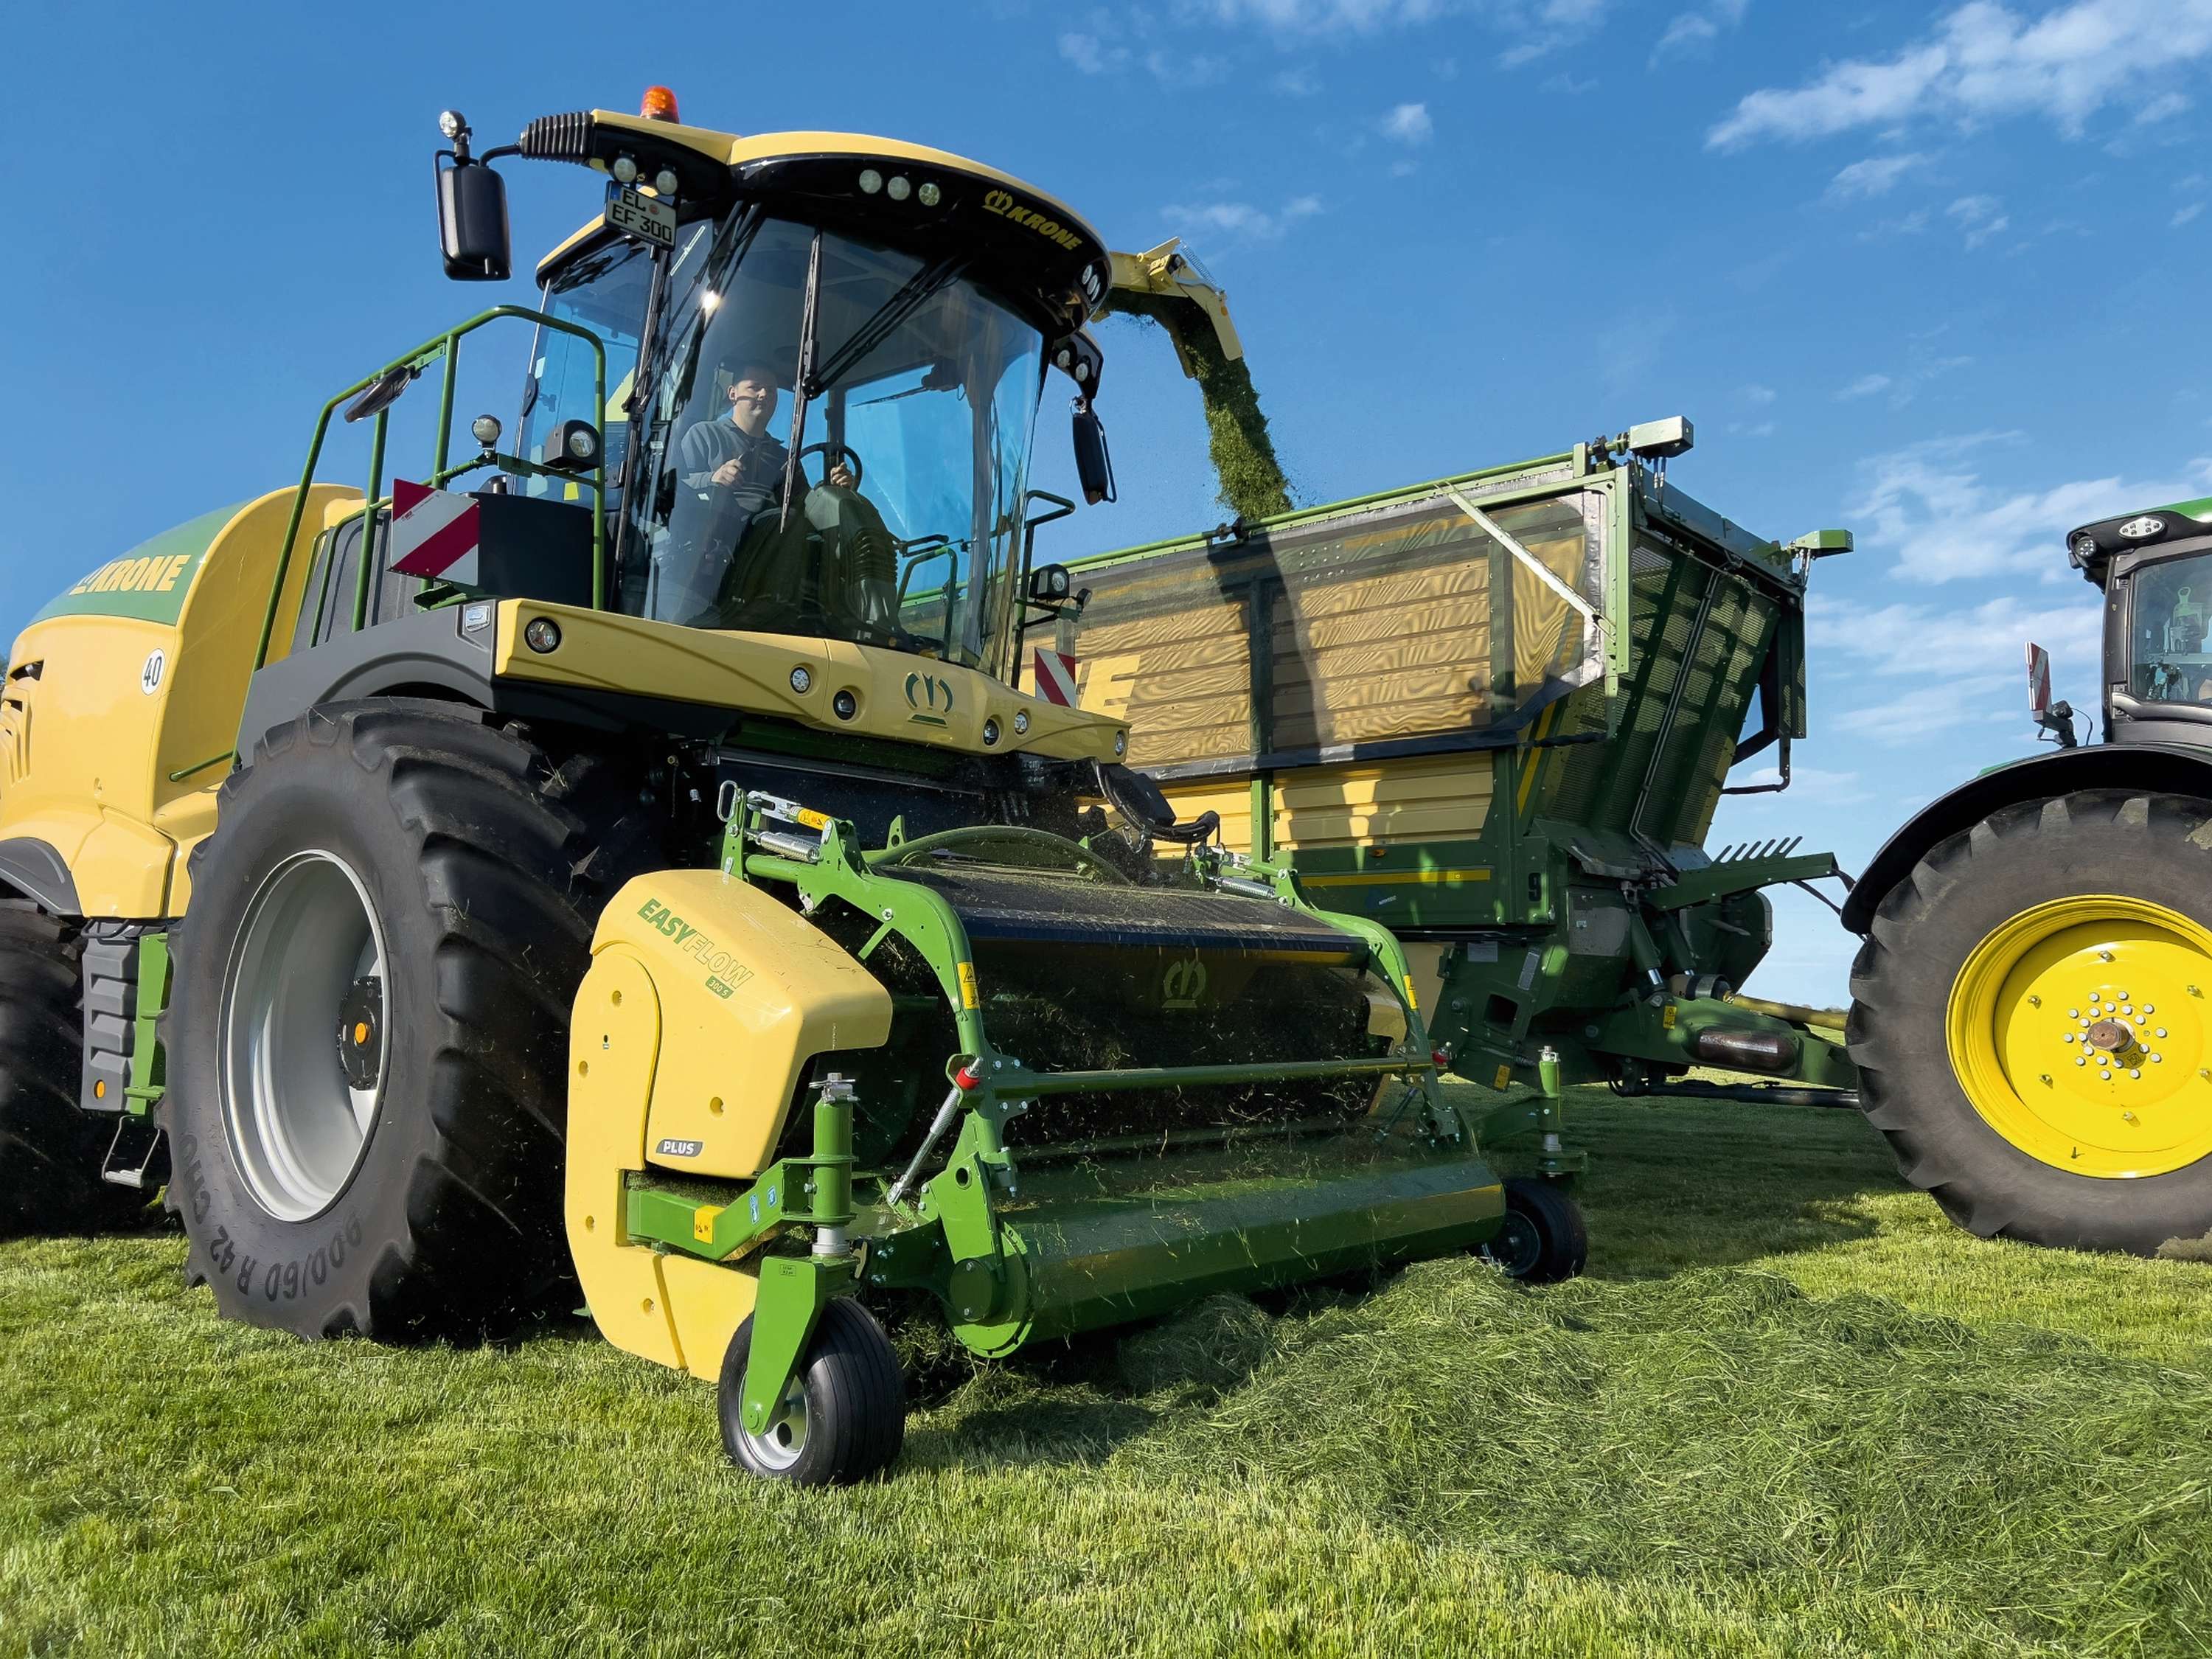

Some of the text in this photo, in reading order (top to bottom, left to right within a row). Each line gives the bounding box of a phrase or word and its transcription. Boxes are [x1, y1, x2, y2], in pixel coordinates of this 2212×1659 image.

[623, 189, 646, 212] EL
[612, 204, 672, 243] EF 300
[1006, 206, 1082, 251] KRONE
[86, 554, 192, 593] KRONE
[144, 655, 162, 686] 40
[637, 898, 754, 990] EASYFLOW
[664, 1141, 694, 1155] PLUS
